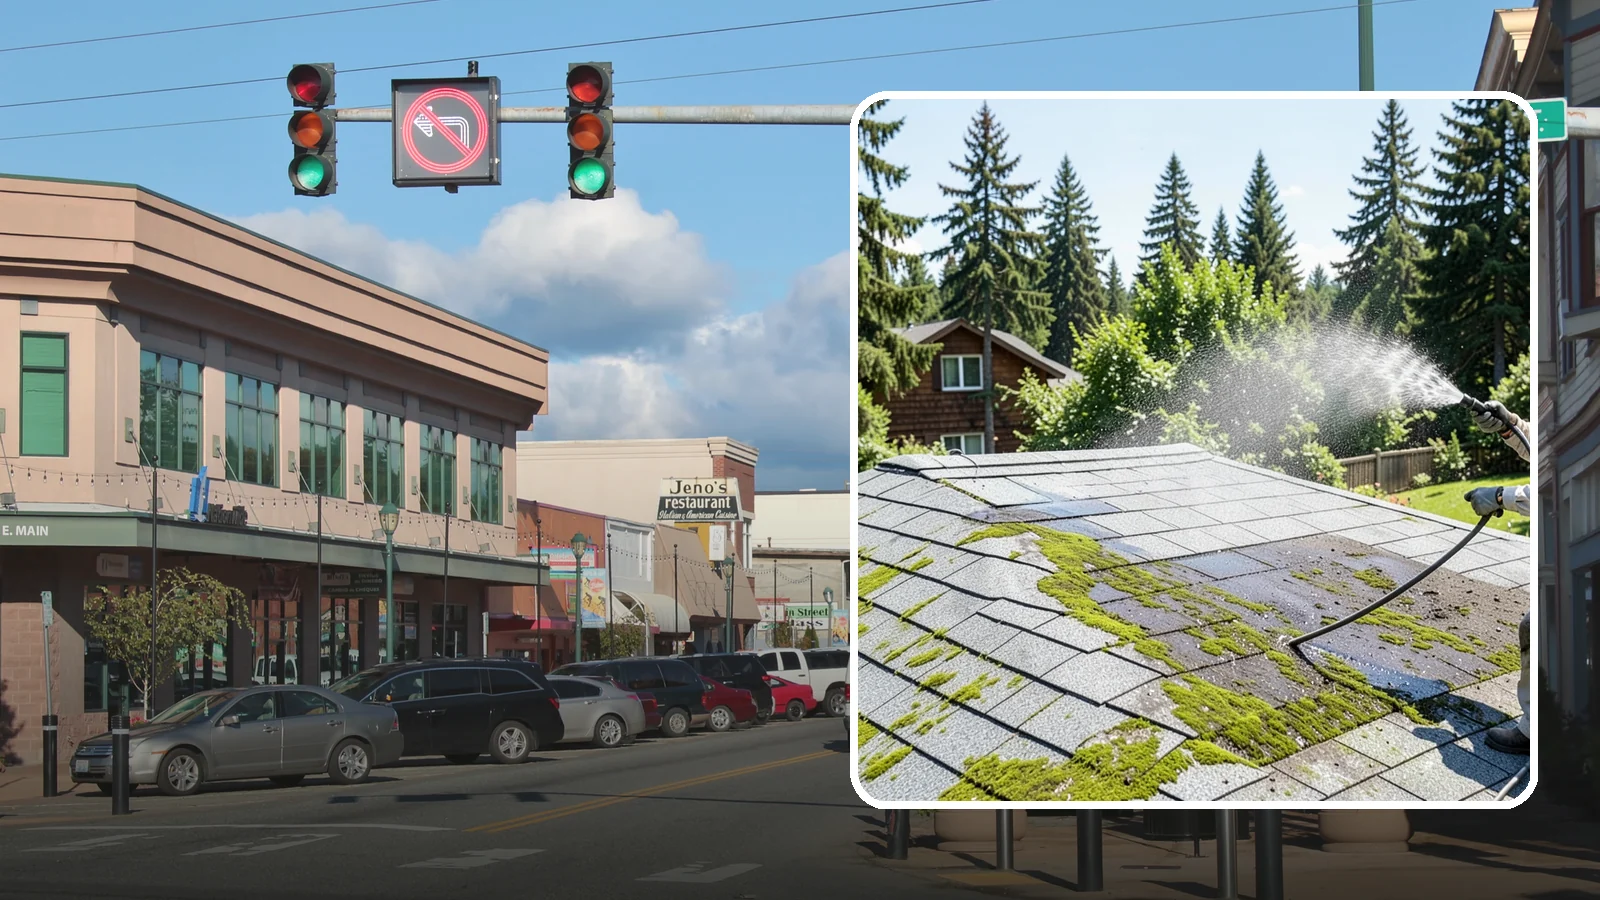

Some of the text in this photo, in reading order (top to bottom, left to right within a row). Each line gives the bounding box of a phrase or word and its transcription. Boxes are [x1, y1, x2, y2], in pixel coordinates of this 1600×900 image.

[669, 480, 728, 495] Jeno's
[665, 496, 731, 509] restaurant
[658, 510, 682, 520] Italian
[685, 510, 715, 520] American
[714, 509, 738, 520] Cuisine
[2, 525, 49, 536] E. MAIN
[797, 607, 829, 617] Street
[788, 619, 824, 627] lass
